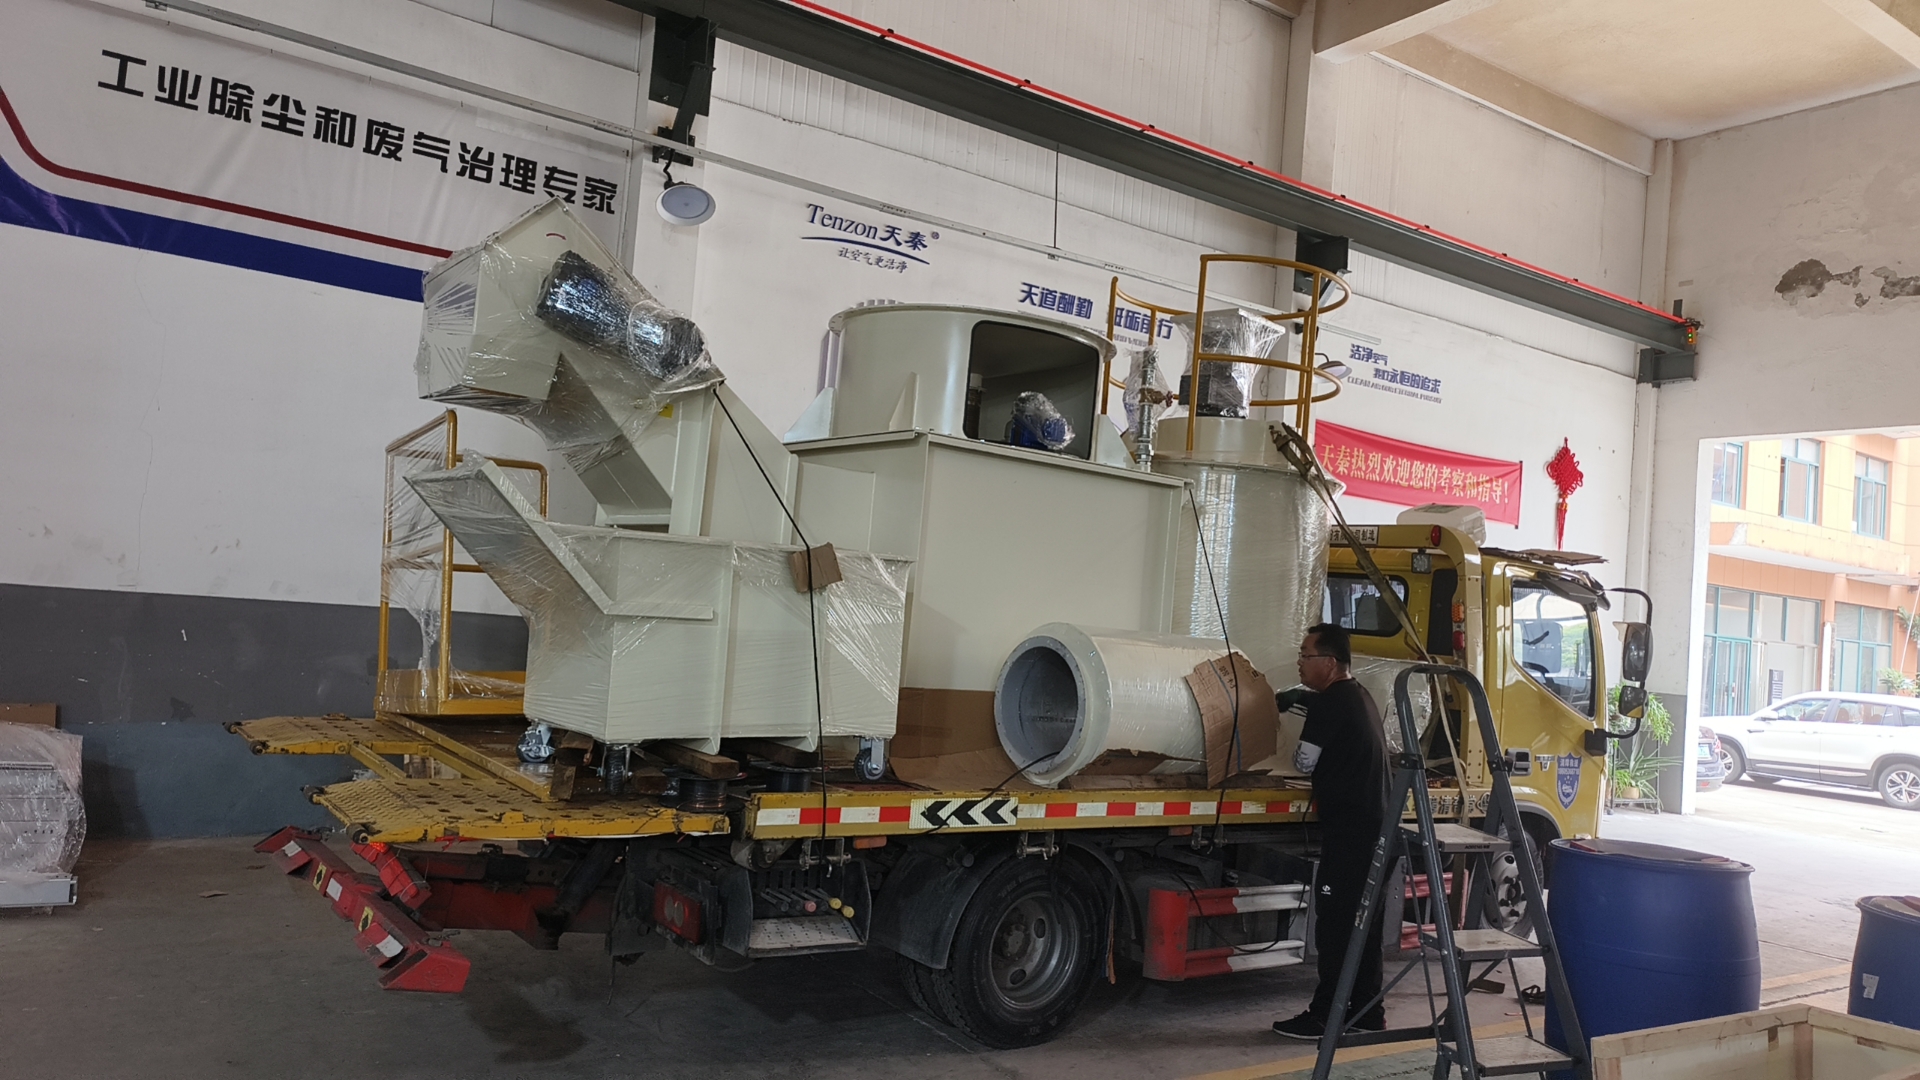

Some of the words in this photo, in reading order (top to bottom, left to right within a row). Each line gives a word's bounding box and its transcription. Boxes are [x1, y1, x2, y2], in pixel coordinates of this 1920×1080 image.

[97, 49, 618, 215] 工业除尘和废气治理专家
[807, 203, 878, 240] Tenzon
[838, 247, 908, 273] 让空气更洁净
[1019, 282, 1094, 320] 天道酬勤
[1349, 343, 1388, 366] 洁净空气
